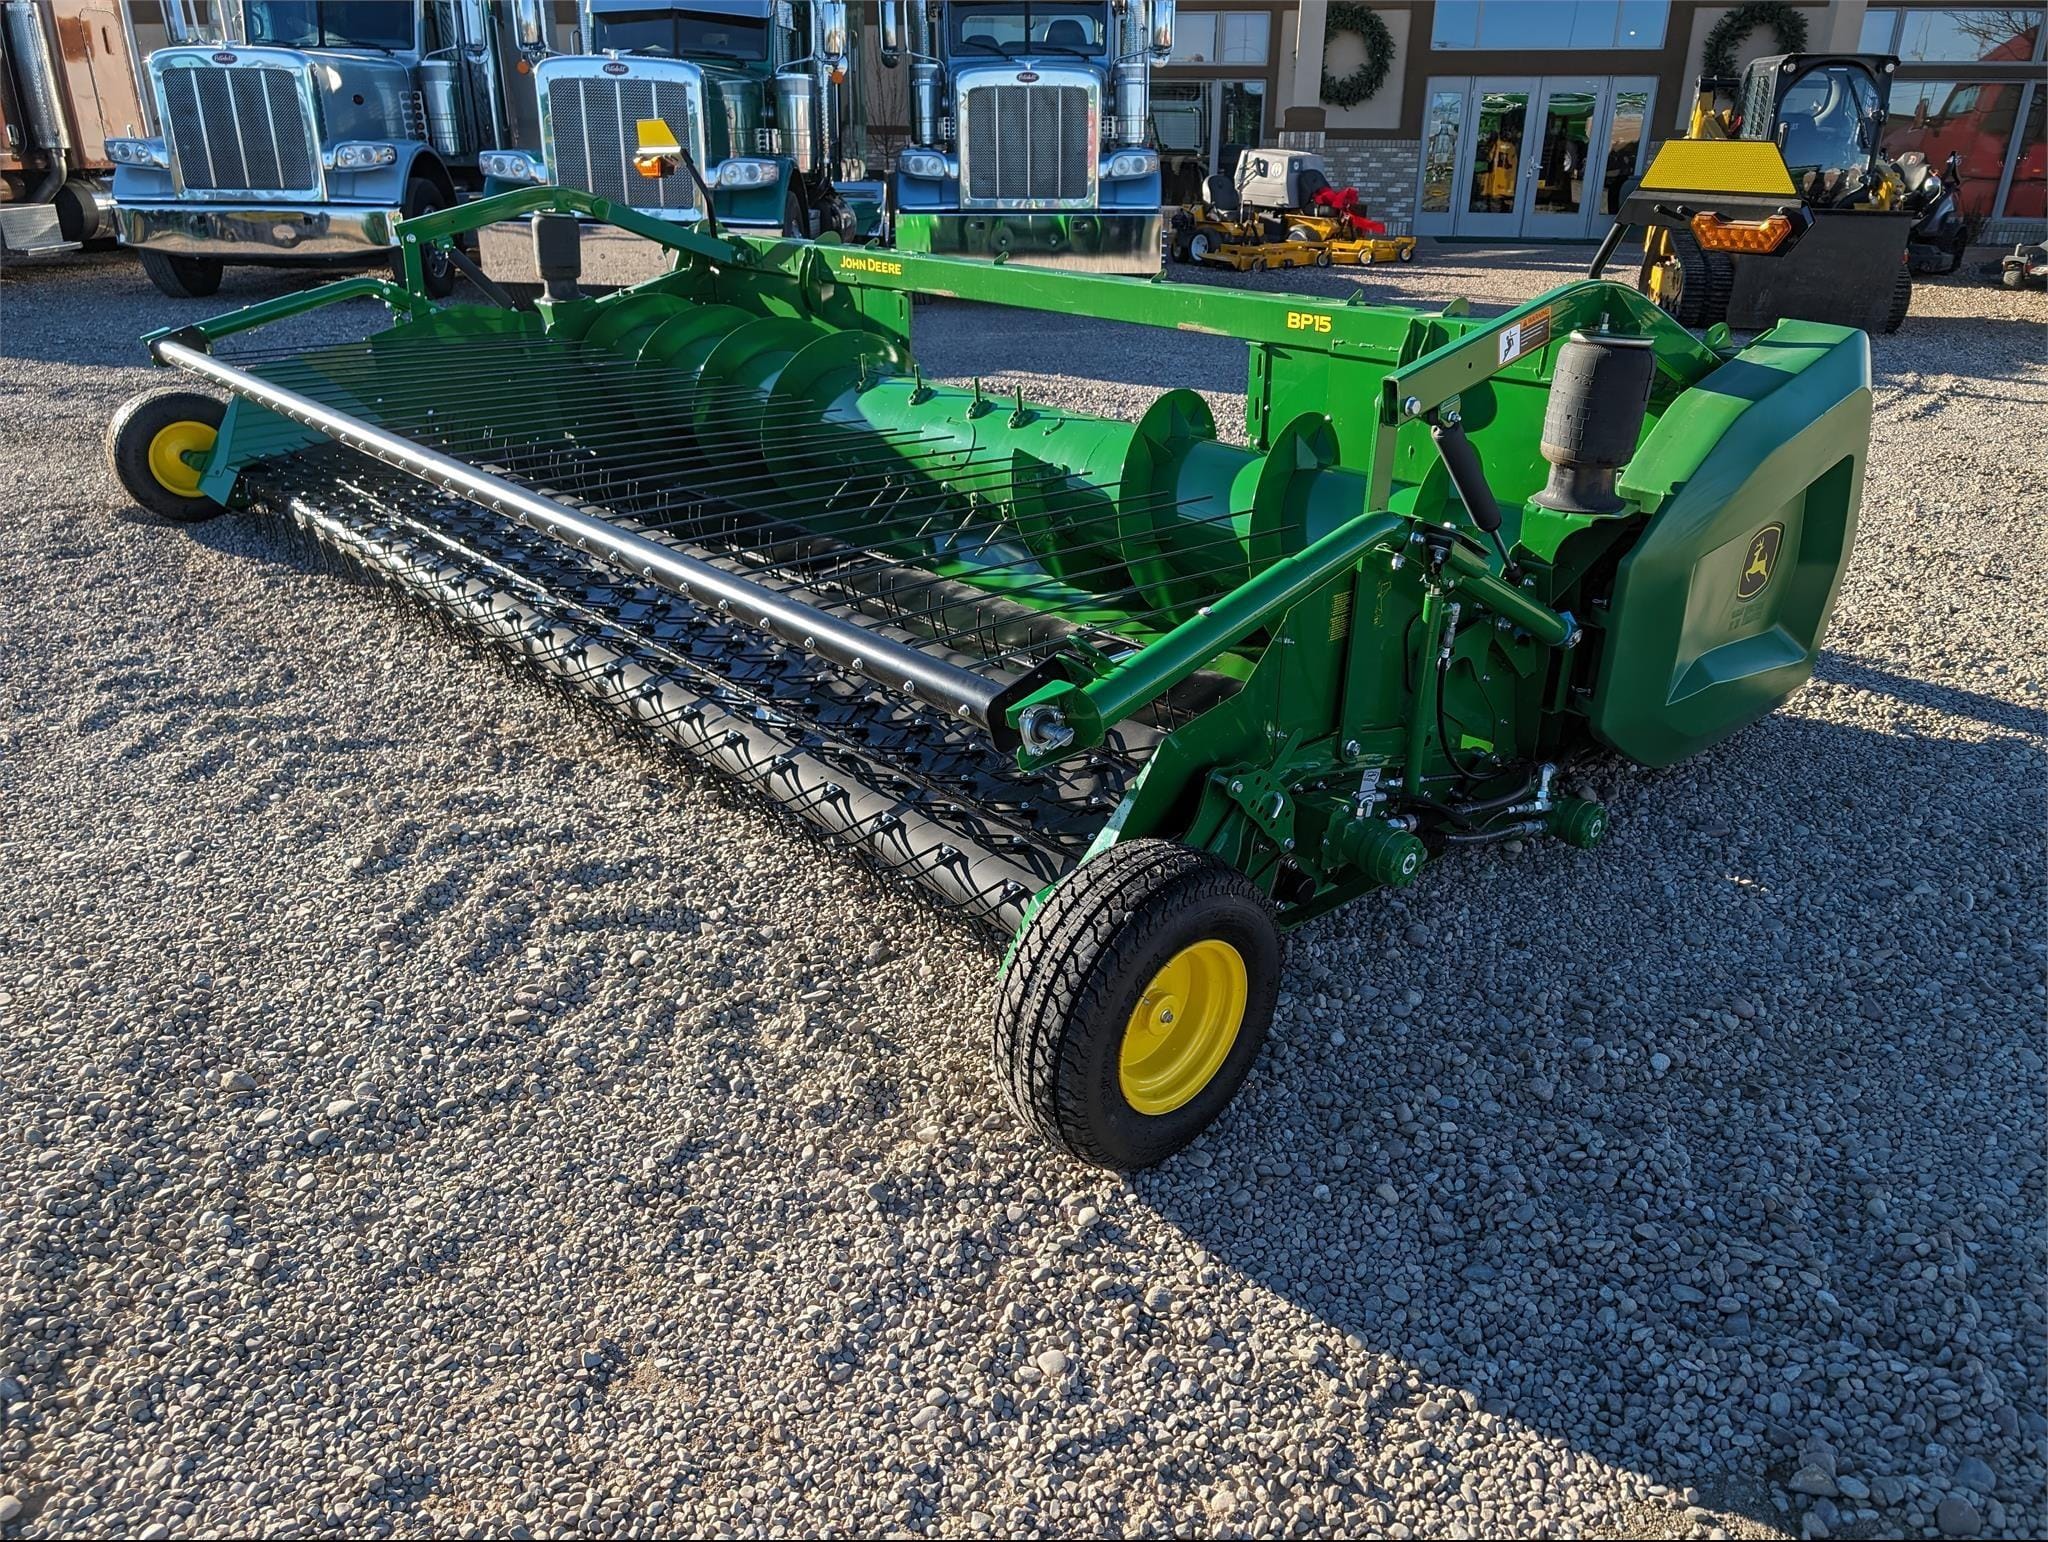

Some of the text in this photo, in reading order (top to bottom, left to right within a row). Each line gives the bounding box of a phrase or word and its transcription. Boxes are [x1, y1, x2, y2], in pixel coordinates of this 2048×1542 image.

[840, 255, 902, 275] JOHN DEERE
[1287, 311, 1332, 333] BP15
